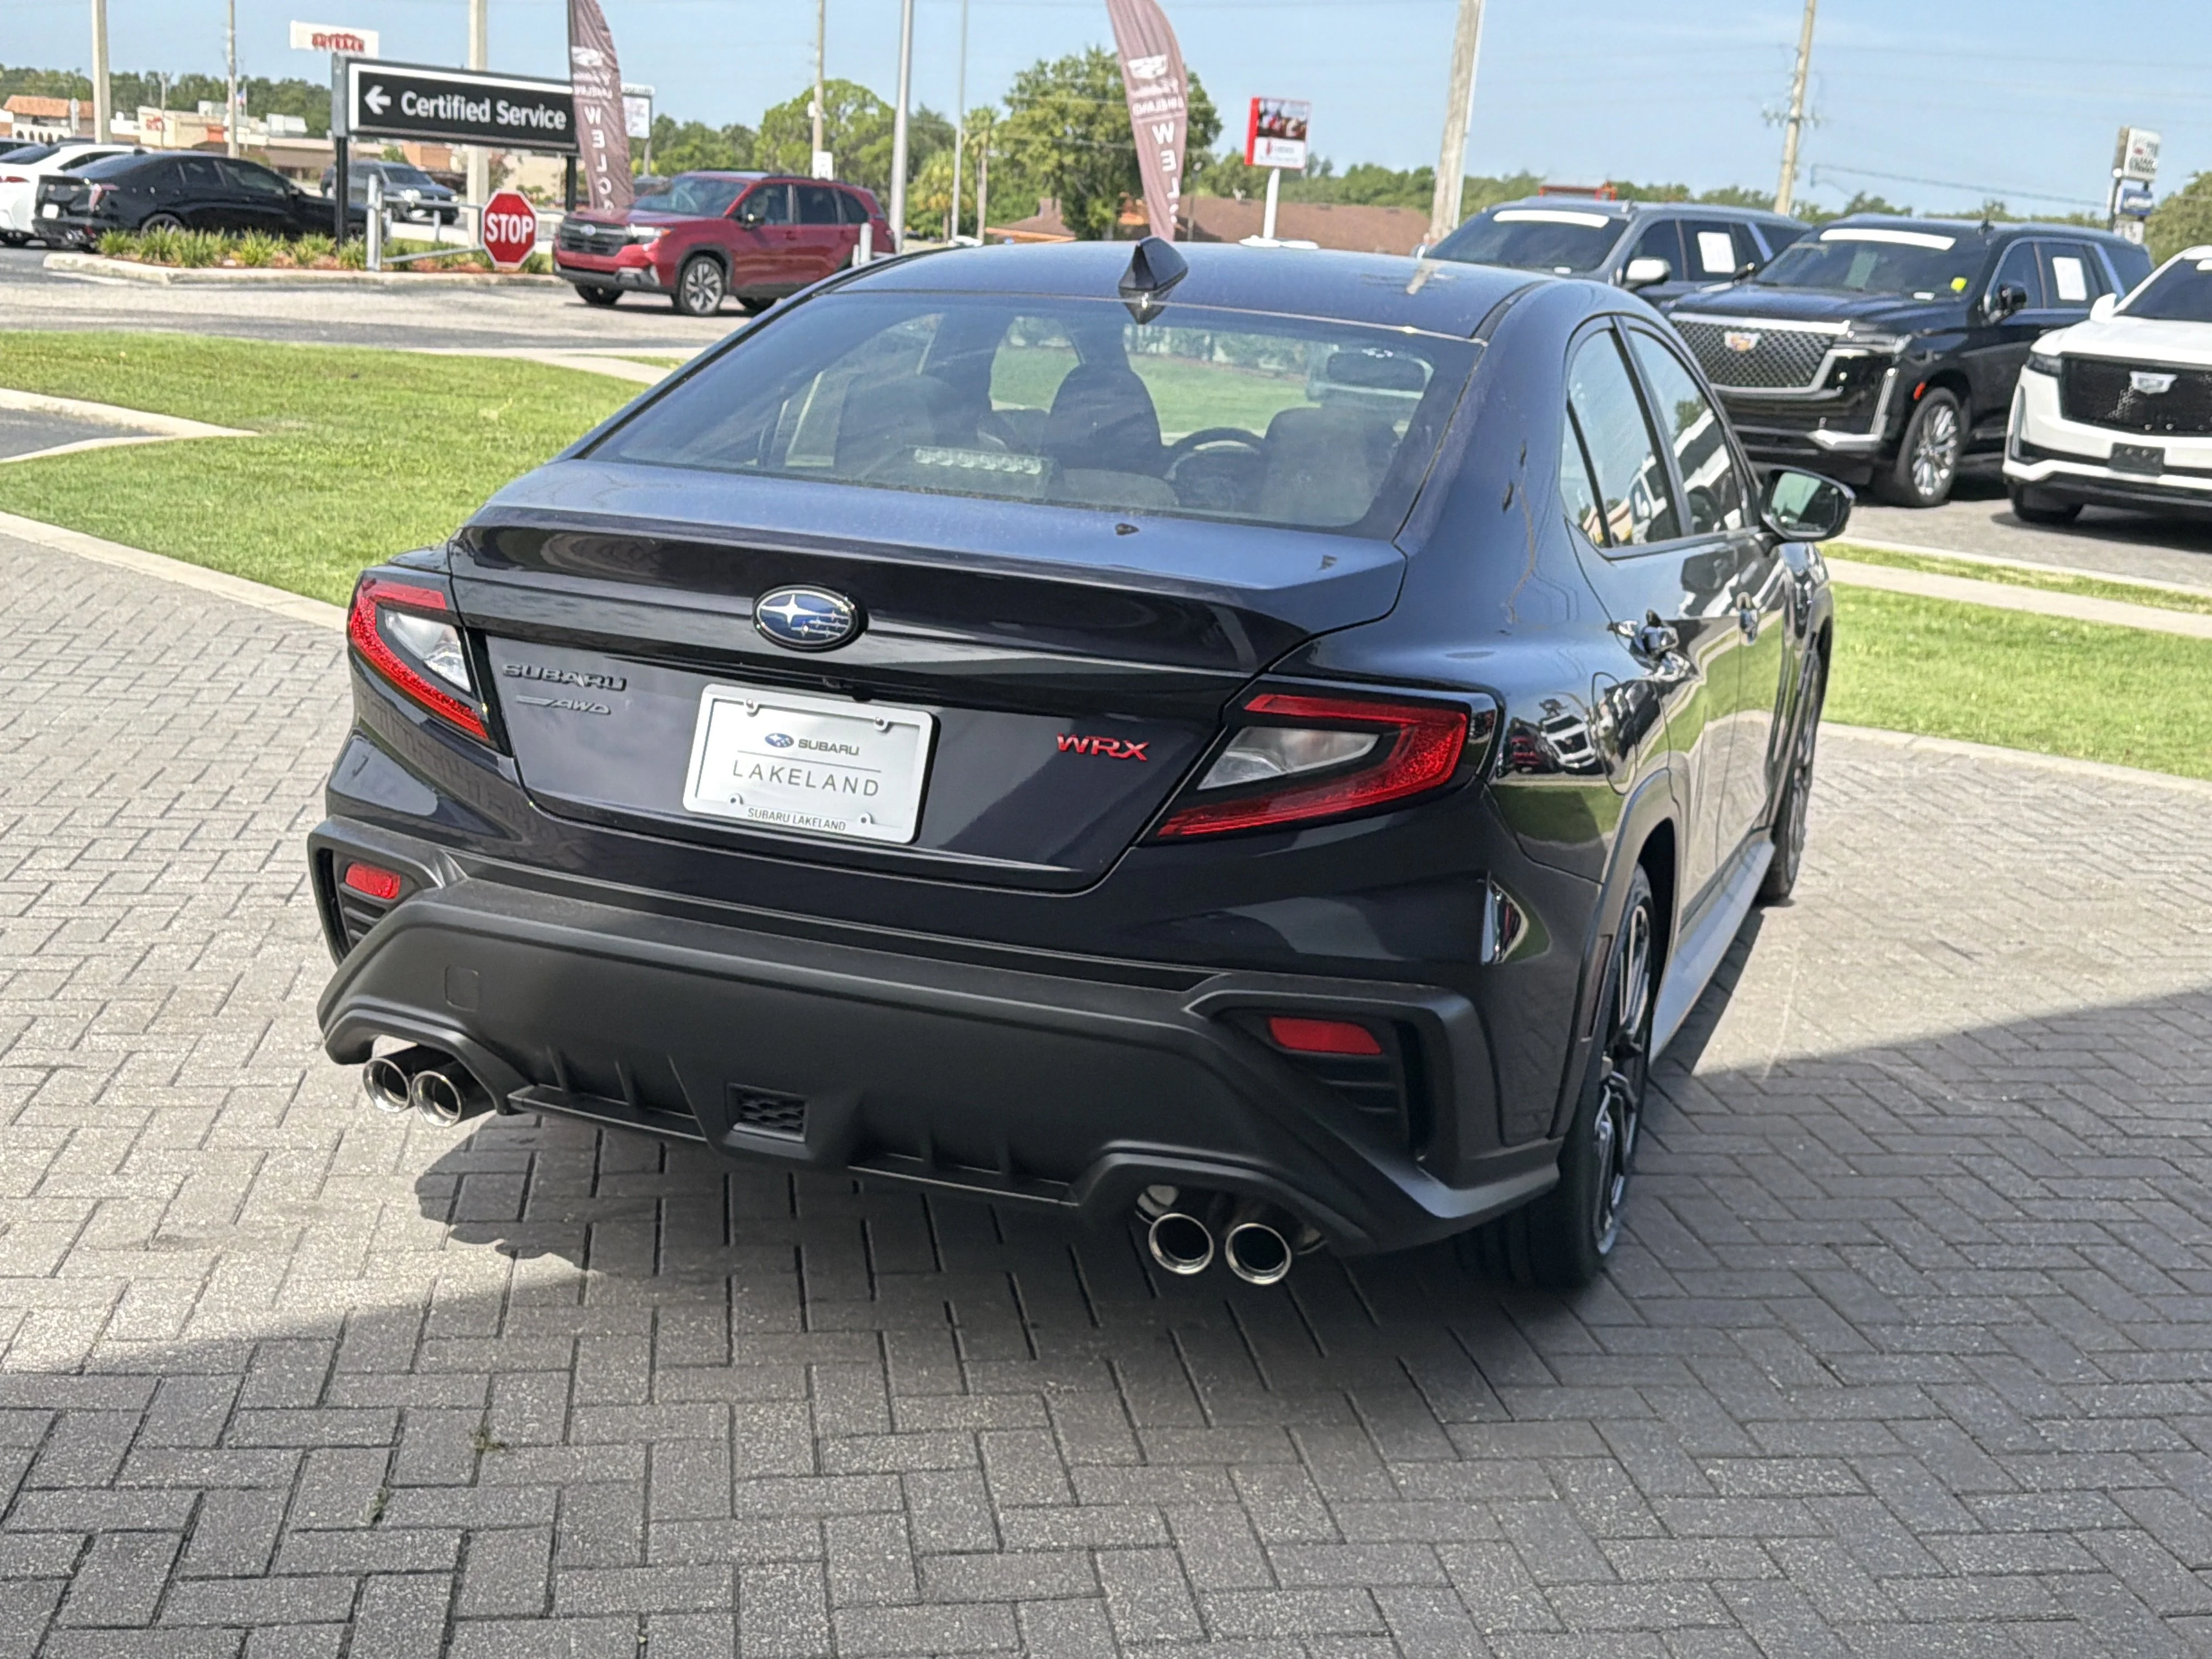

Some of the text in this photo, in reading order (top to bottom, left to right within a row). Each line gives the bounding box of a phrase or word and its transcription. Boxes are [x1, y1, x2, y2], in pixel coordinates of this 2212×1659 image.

[401, 91, 567, 130] Certified Service
[486, 213, 534, 244] STOP
[501, 663, 628, 691] SUBARU
[549, 698, 612, 715] AWD
[798, 738, 860, 756] SUBARU
[1057, 732, 1149, 762] WRX
[733, 759, 879, 797] LAKELAND
[747, 807, 847, 831] SUBARU LAKELAND
